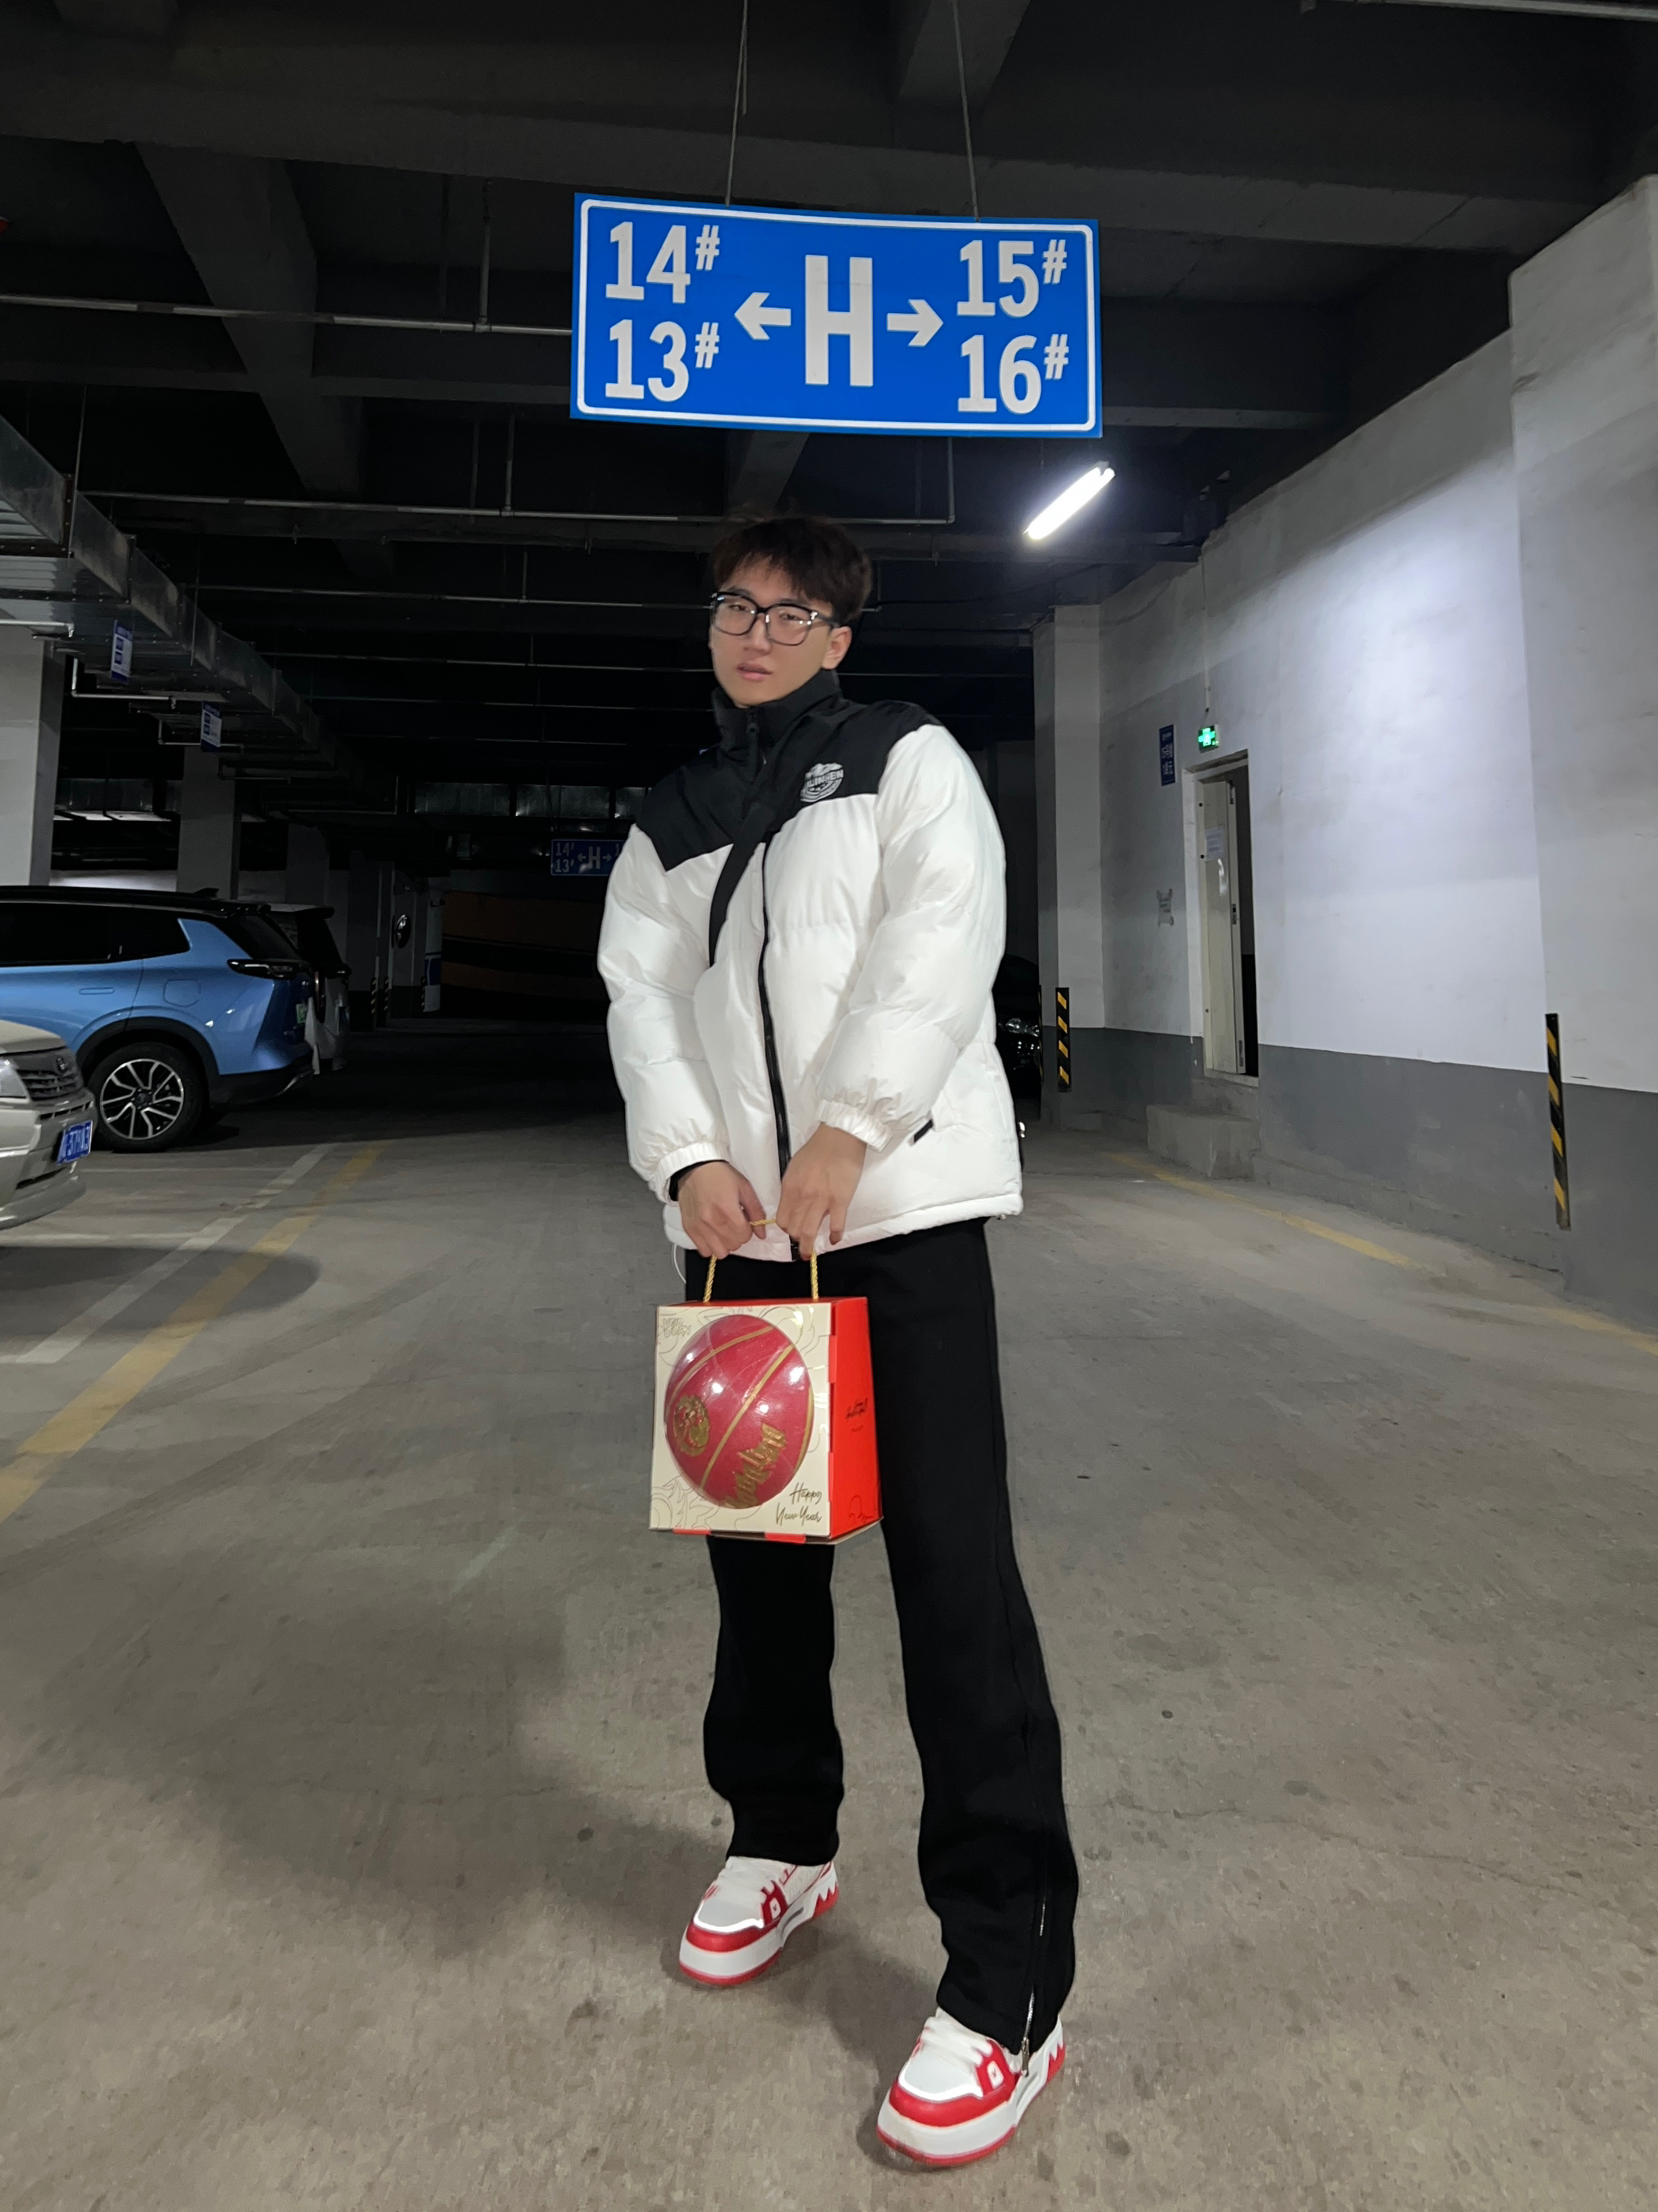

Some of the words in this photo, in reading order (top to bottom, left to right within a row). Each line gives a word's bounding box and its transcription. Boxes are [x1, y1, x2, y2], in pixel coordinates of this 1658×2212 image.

[804, 254, 874, 387] H
[588, 846, 601, 870] H
[789, 1482, 823, 1505] Happy
[776, 1502, 799, 1526] New
[799, 1505, 823, 1526] Year
